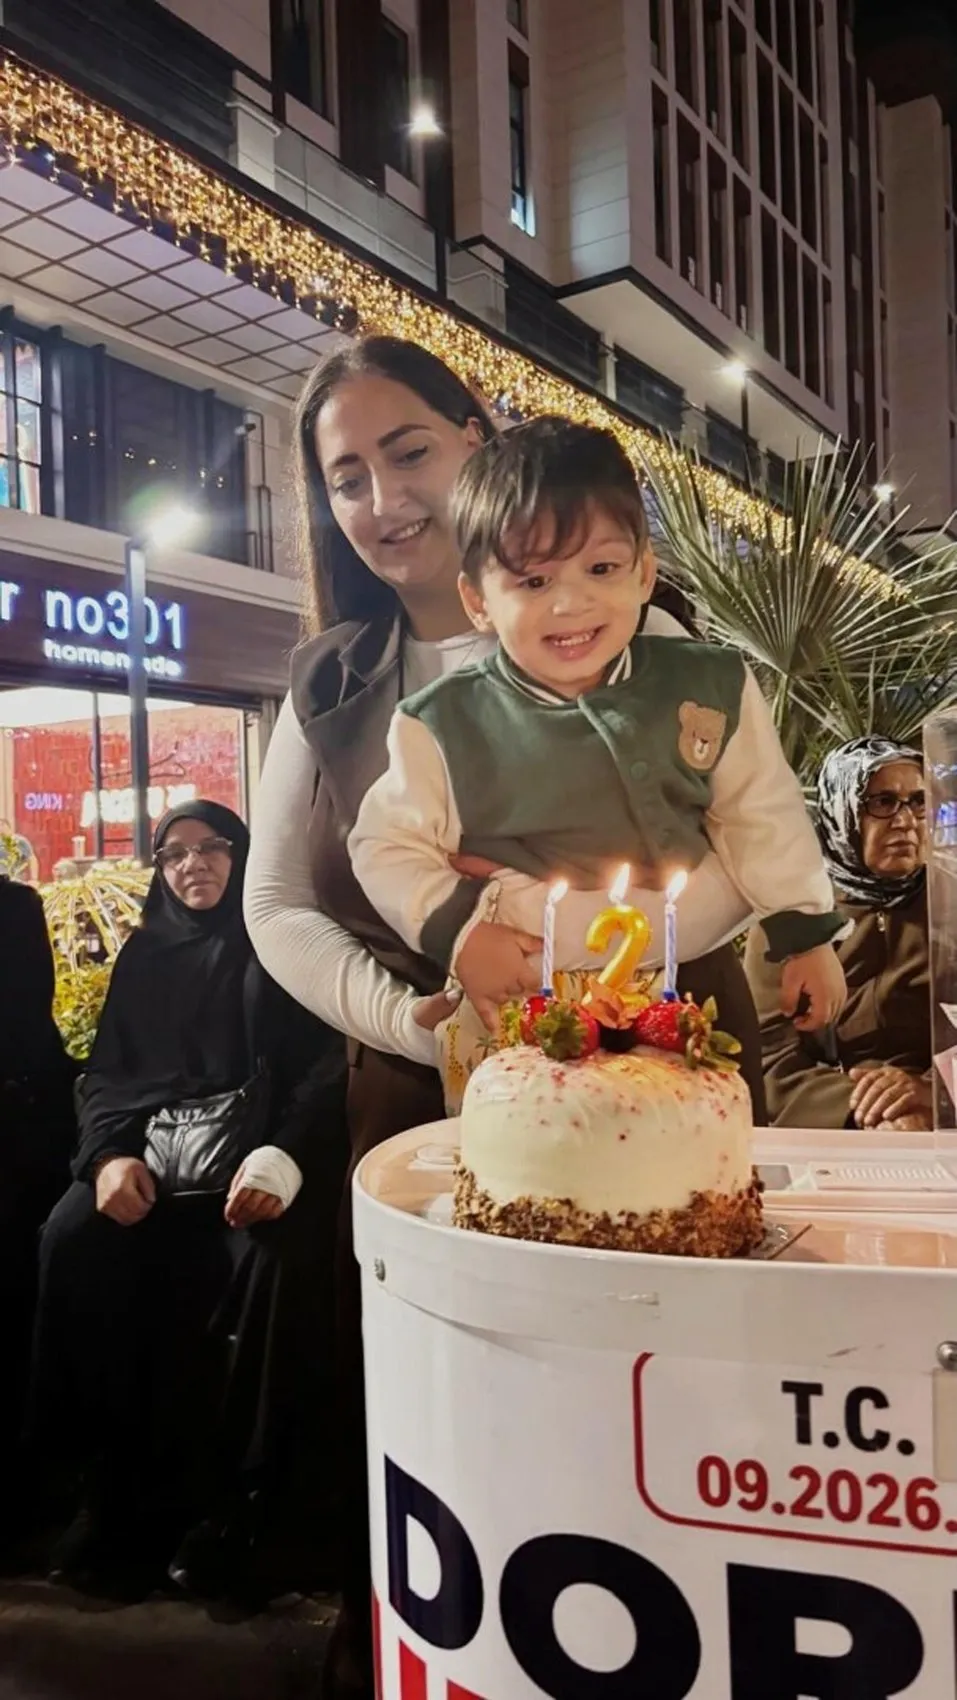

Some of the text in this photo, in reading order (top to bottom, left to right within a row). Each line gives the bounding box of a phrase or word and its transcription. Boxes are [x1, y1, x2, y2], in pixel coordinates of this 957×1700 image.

[585, 904, 653, 1006] 2
[780, 1380, 915, 1456] T.C.
[384, 1452, 957, 1700] DOR
